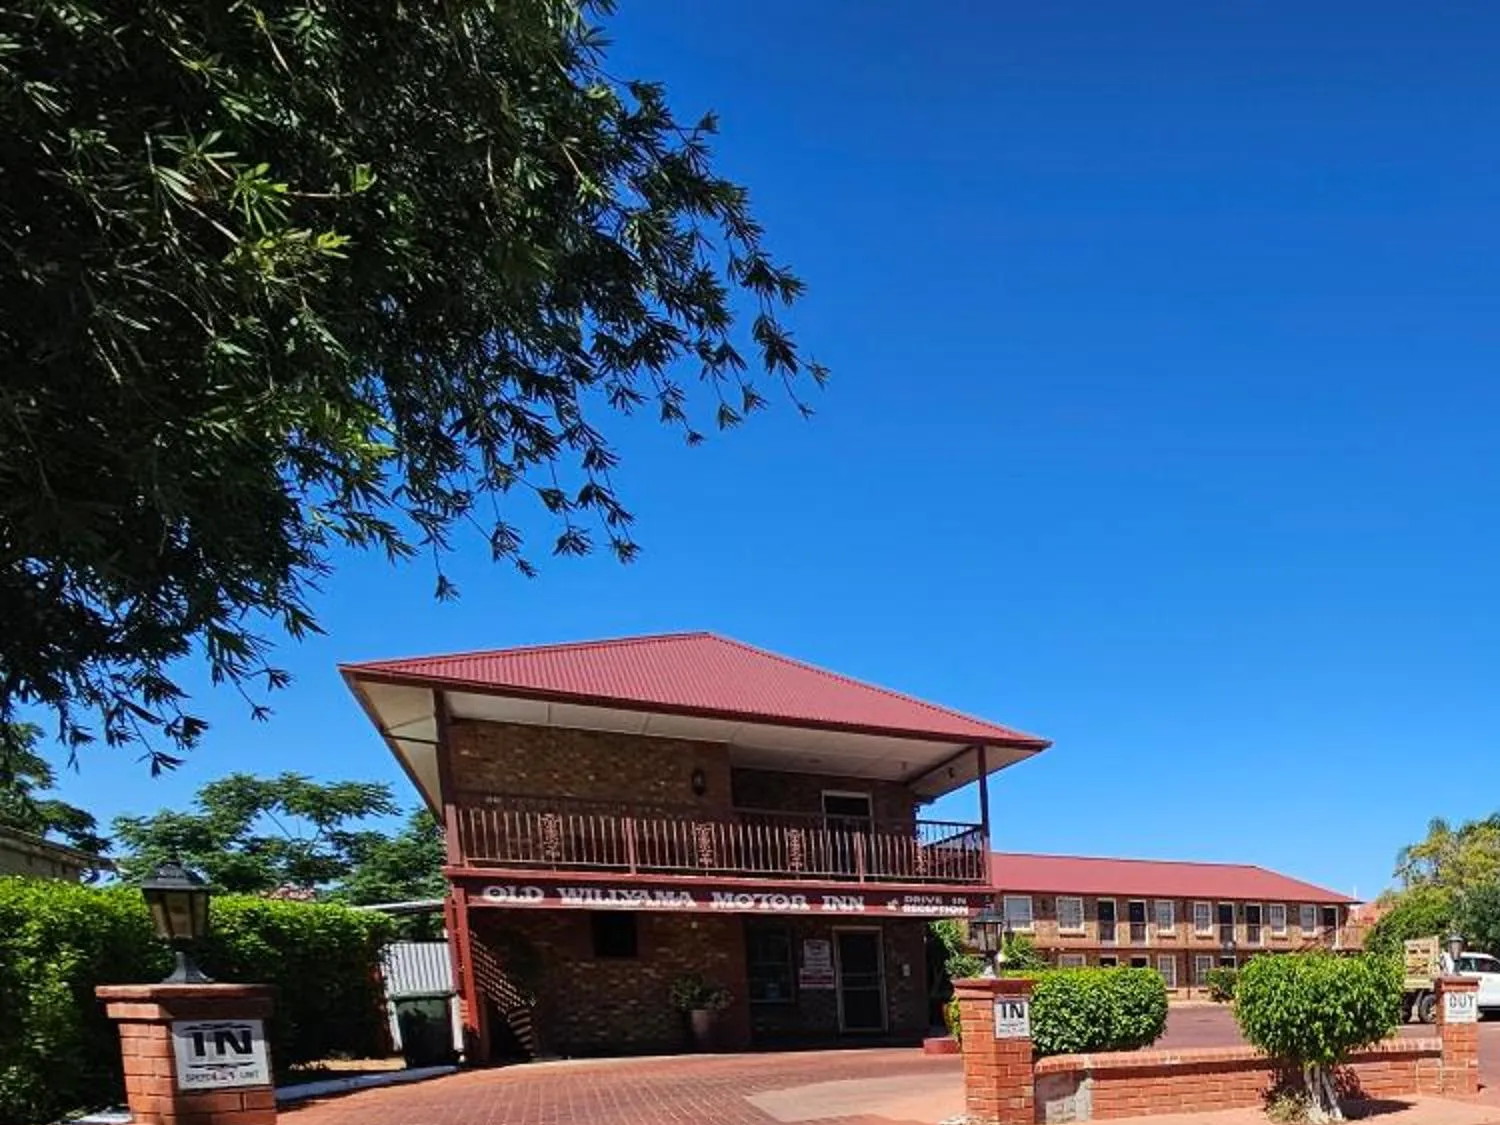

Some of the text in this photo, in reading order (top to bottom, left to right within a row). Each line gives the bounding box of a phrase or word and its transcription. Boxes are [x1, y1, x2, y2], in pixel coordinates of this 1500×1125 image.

[482, 885, 865, 911] OLD WILLYAMA MOTOR INN
[904, 895, 942, 904] DRIVE
[1449, 994, 1474, 1009] OUT
[1001, 1002, 1024, 1019] IN
[191, 1030, 253, 1057] IN
